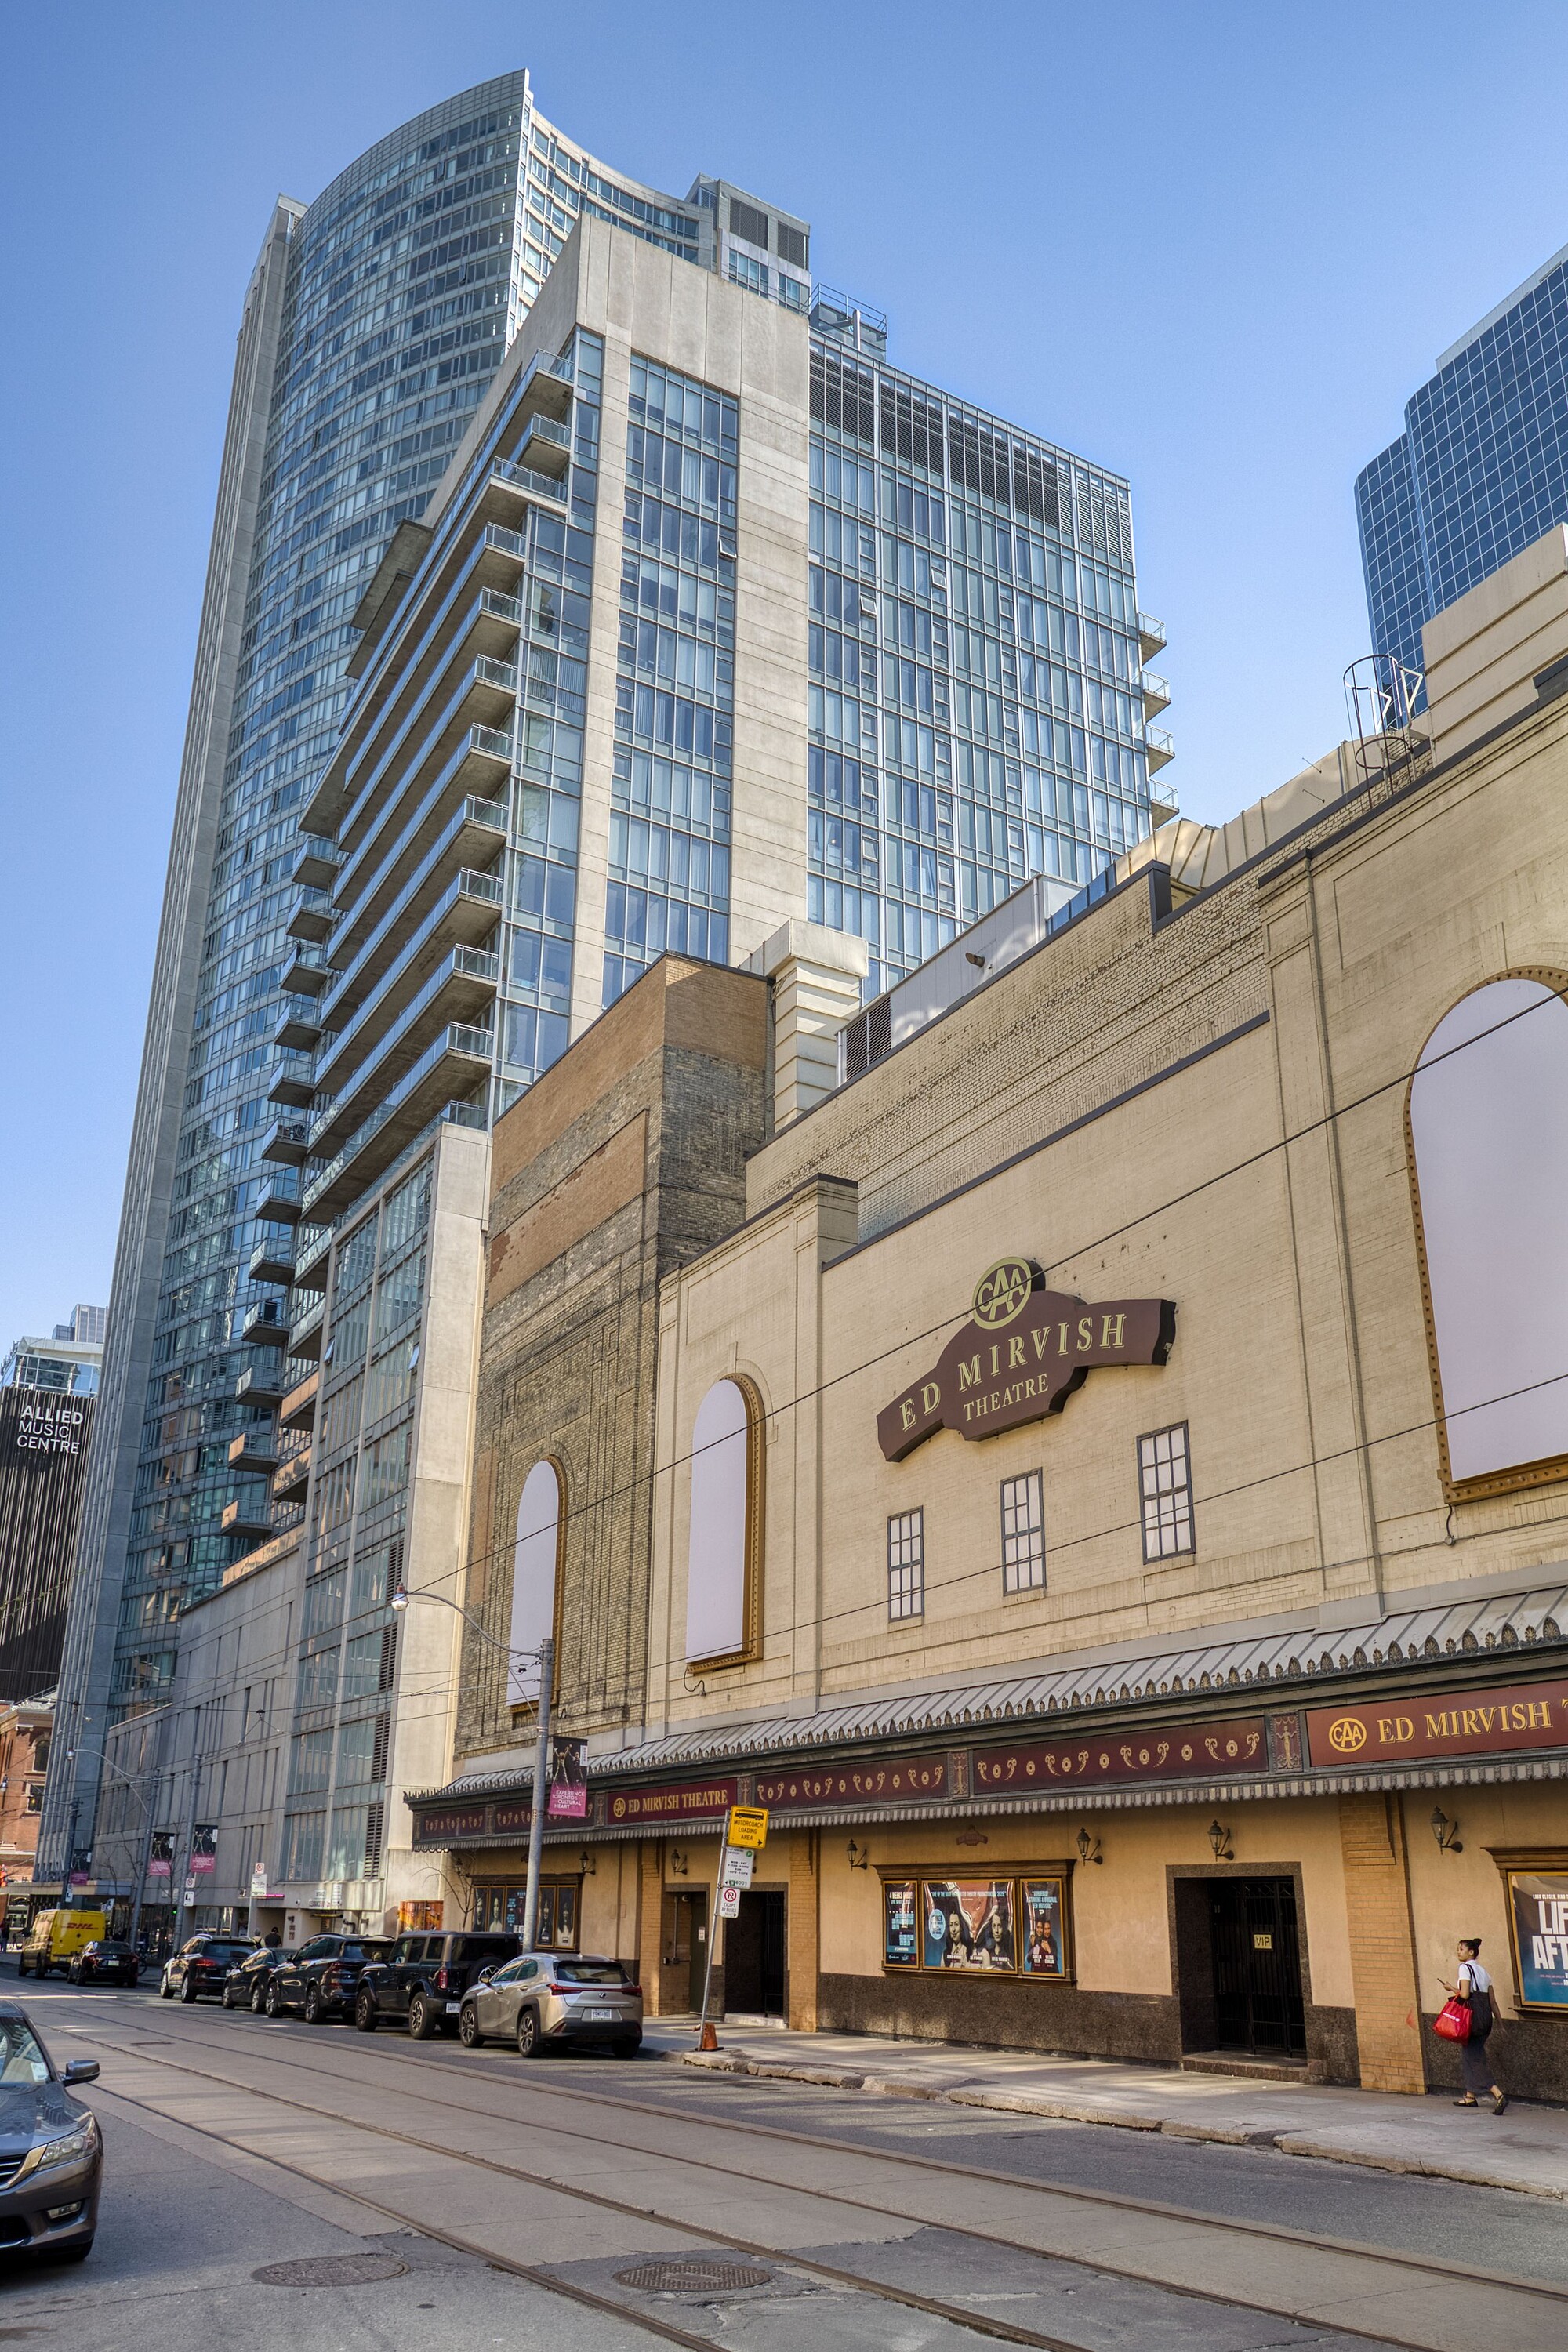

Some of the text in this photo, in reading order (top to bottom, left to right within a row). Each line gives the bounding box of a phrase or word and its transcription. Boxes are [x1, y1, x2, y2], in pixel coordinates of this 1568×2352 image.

[978, 1266, 1025, 1321] CAA
[898, 1313, 1127, 1433] ED MIRVISH
[962, 1373, 1050, 1422] THEATRE
[21, 1405, 84, 1425] ALLIED
[18, 1420, 70, 1439] MUSIC
[16, 1434, 81, 1455] CENTRE
[1332, 1722, 1363, 1748] CAA
[1377, 1717, 1415, 1744] ED
[1424, 1700, 1554, 1740] MIRVISH
[552, 1793, 579, 1802] TORONTO'S
[556, 1789, 585, 1798] EXPERIENCE
[628, 1799, 641, 1813] ED
[643, 1795, 680, 1813] MIRVISH
[681, 1789, 728, 1808] THEATRE
[734, 1820, 764, 1828] MOTORCOACH
[1256, 1936, 1270, 1947] VIP
